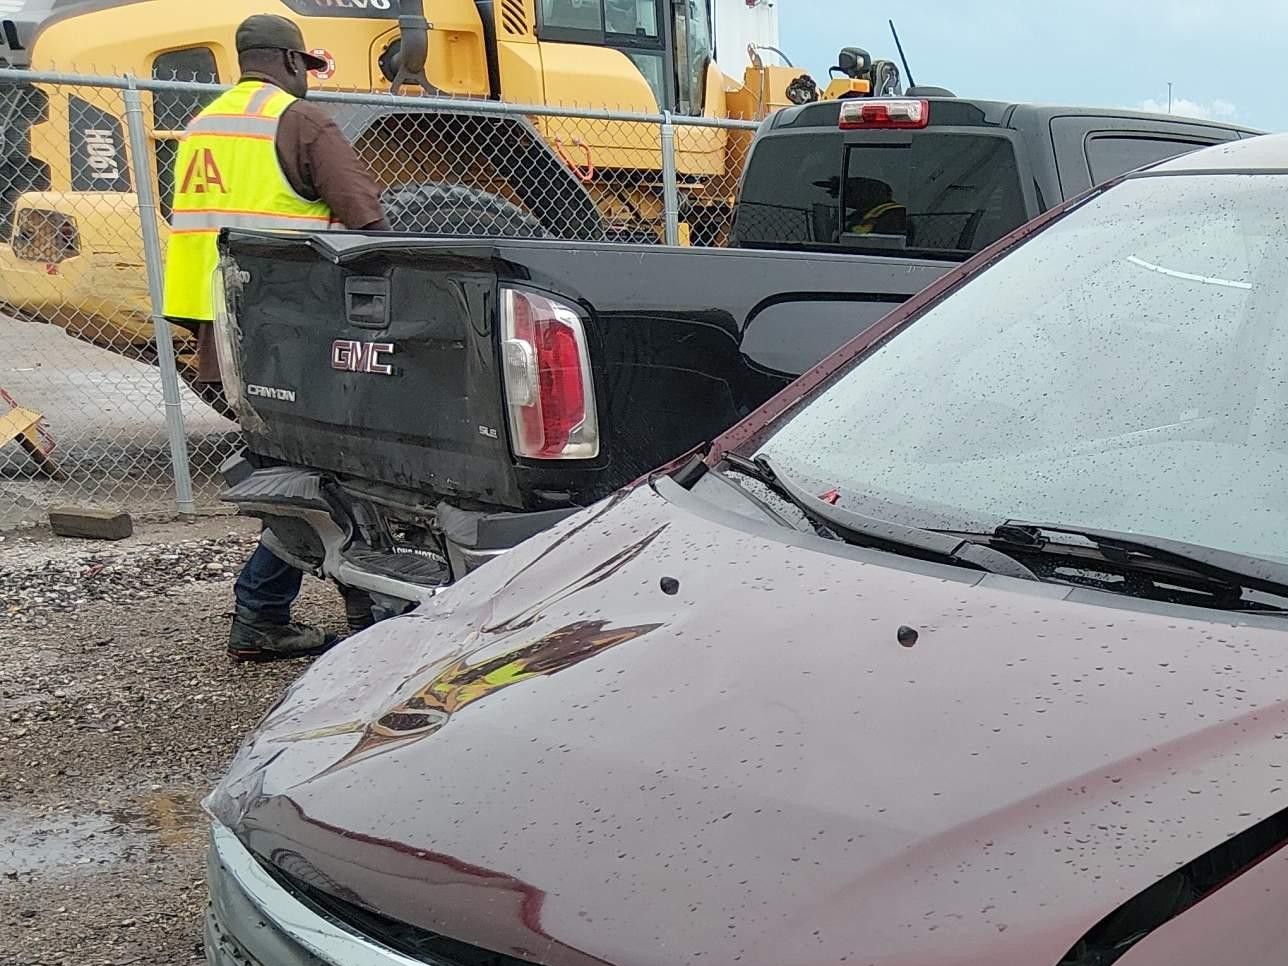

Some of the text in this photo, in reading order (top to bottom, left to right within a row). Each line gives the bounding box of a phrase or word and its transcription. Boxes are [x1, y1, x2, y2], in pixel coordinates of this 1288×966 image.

[85, 129, 120, 180] L90H
[331, 340, 394, 375] GMC
[247, 384, 296, 402] CANYON
